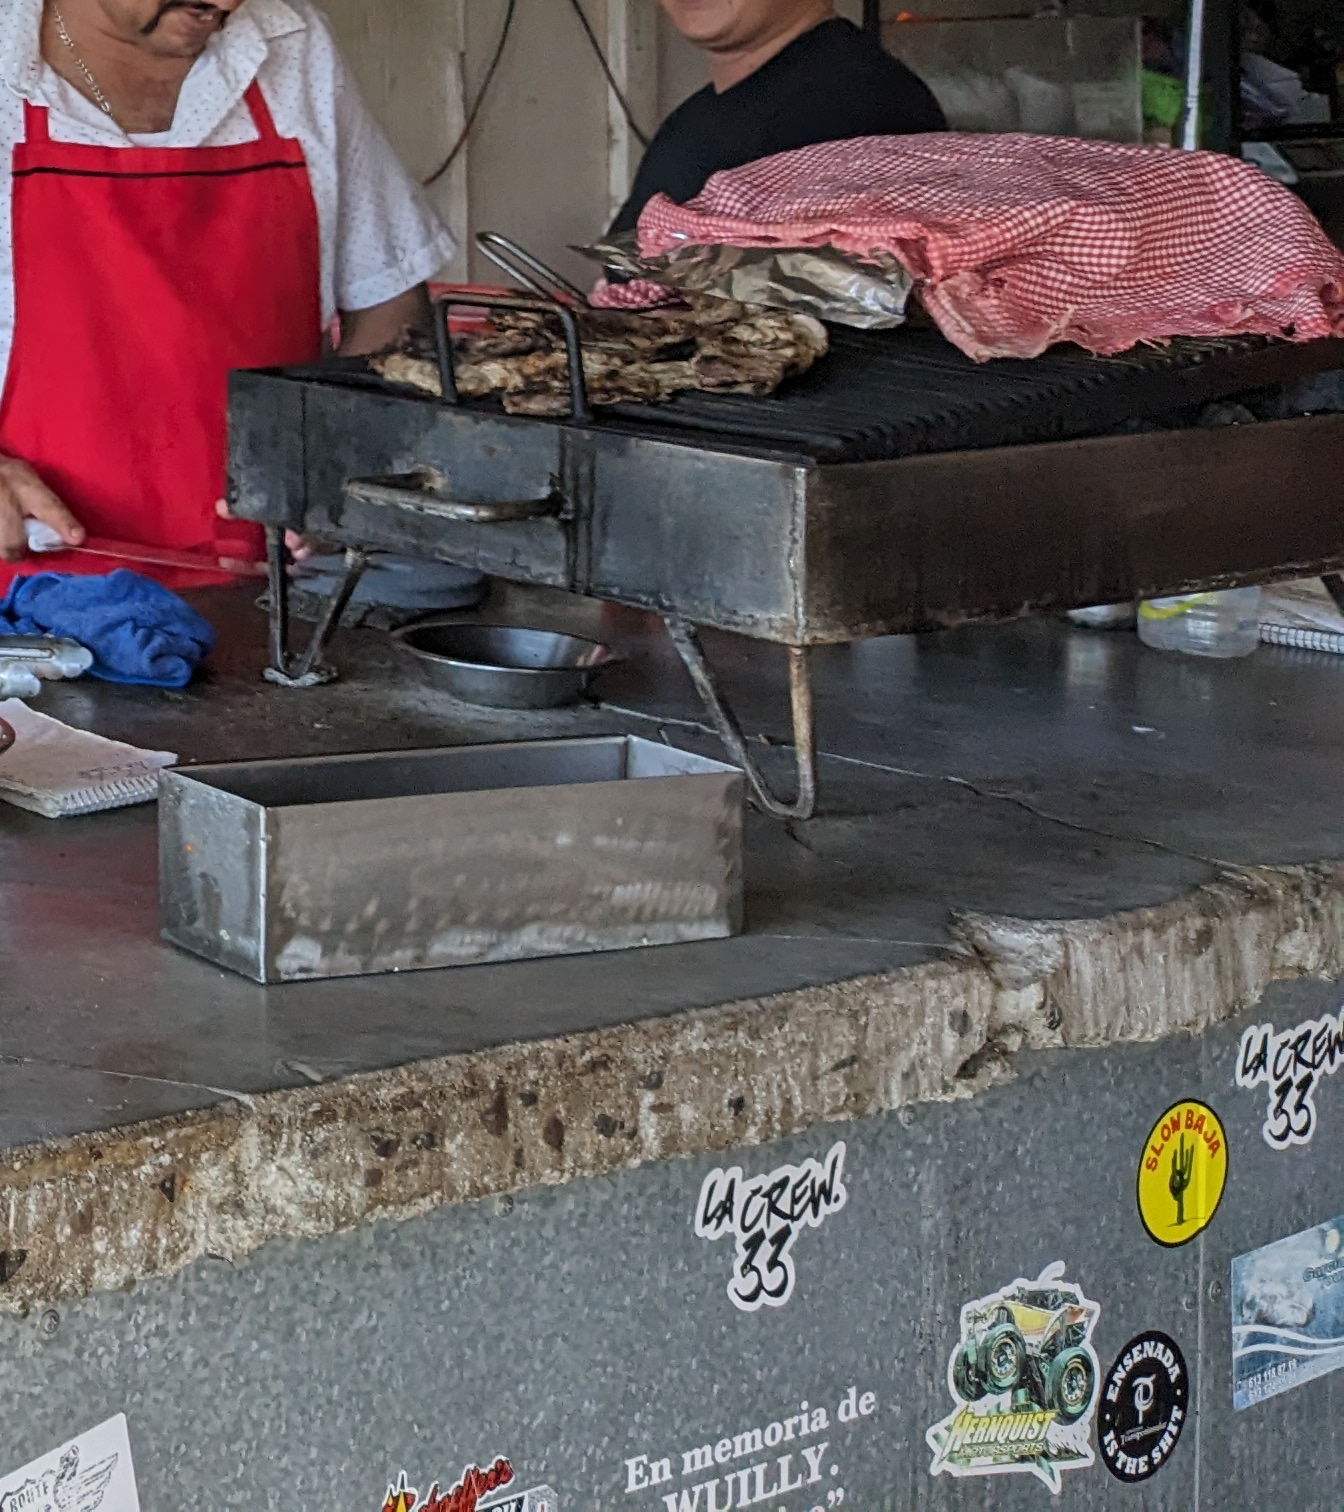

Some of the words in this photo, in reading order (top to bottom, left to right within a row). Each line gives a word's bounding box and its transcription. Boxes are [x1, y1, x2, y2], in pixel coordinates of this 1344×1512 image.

[1241, 1033, 1269, 1080] LA
[1268, 1071, 1314, 1143] 33
[1146, 1110, 1182, 1173] SLOW
[1184, 1108, 1222, 1160] BAJA
[702, 1178, 736, 1232] LA
[734, 1223, 792, 1303] 33
[1106, 1340, 1181, 1403] ENSENADA
[625, 1454, 673, 1493] En
[681, 1400, 830, 1475] memoria
[837, 1385, 877, 1423] de
[939, 1405, 1056, 1458] HERNQUIST
[1103, 1428, 1118, 1458] IS
[1115, 1449, 1149, 1476] THE
[1151, 1404, 1184, 1466] SHIT
